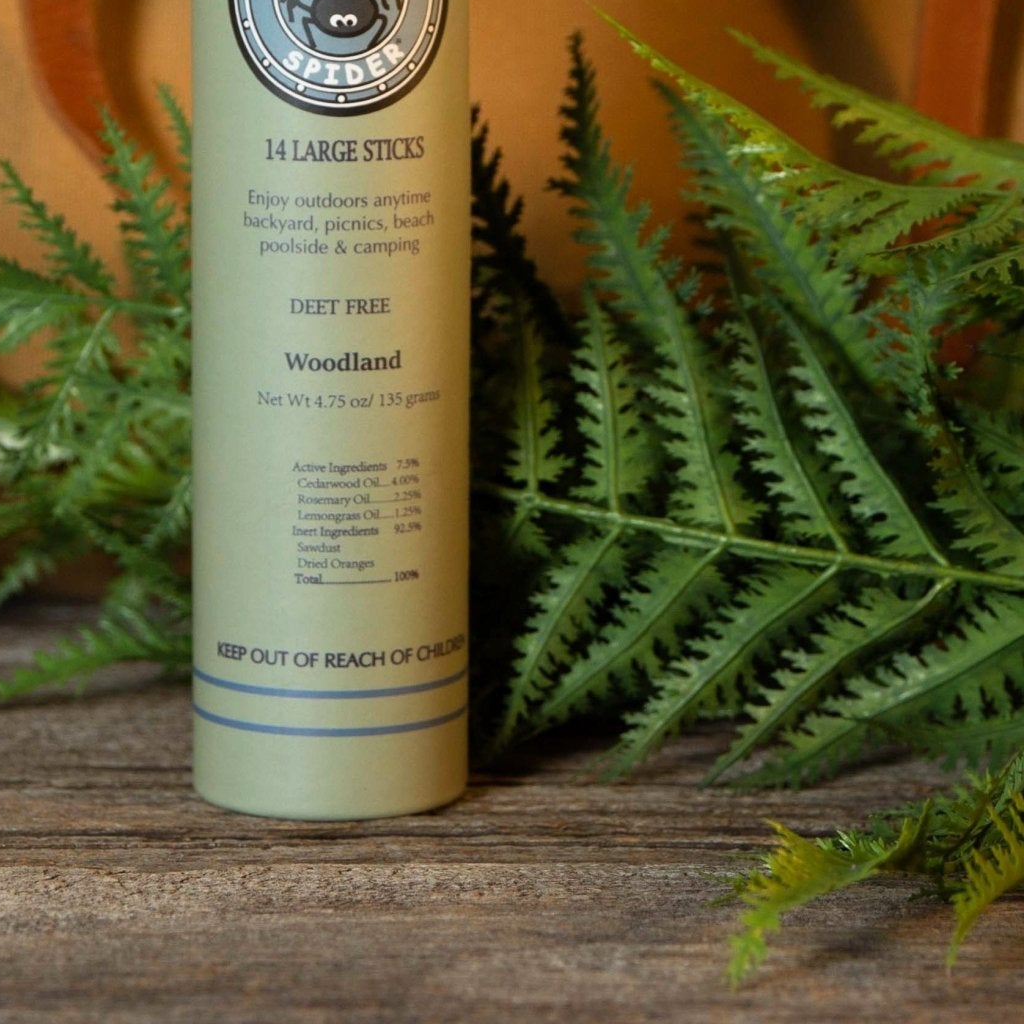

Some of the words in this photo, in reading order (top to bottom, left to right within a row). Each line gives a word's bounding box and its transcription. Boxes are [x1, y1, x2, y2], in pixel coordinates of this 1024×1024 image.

[282, 43, 406, 85] SPIDER
[265, 138, 287, 162] 14
[292, 140, 358, 162] LARGE
[363, 136, 425, 162] STICKS
[248, 190, 289, 210] Enjoy
[294, 193, 368, 209] outdoors
[373, 191, 431, 210] anytime
[243, 211, 318, 232] backyard,
[325, 217, 388, 235] picnics,
[393, 211, 434, 229] beach
[259, 238, 328, 256] poolside
[334, 240, 347, 255] &
[353, 238, 420, 257] camping
[290, 299, 340, 315] DEET
[345, 298, 390, 314] FREE
[285, 350, 402, 372] Woodland
[257, 391, 282, 407] Net
[287, 393, 310, 407] Wt
[314, 395, 345, 408] 4.75
[379, 392, 402, 407] 135
[405, 389, 440, 409] grams
[292, 462, 325, 473] Active
[328, 461, 387, 476] Ingredients
[297, 478, 360, 489] Cedarwood
[363, 478, 379, 488] Oil
[297, 494, 351, 507] Rosemary
[353, 494, 370, 504] Oil
[298, 510, 360, 524] Lemongrass
[363, 510, 380, 520] Oil
[292, 526, 317, 536] Inert
[320, 526, 379, 539] Ingredients
[297, 542, 341, 553] Sawdust
[297, 558, 327, 569] Dried
[331, 558, 375, 571] Oranges
[294, 573, 323, 585] Total
[395, 569, 419, 582] 100%
[217, 642, 247, 660] KEEP
[250, 648, 288, 666] OUT
[293, 652, 319, 668] OF
[325, 651, 386, 668] REACH
[391, 648, 413, 665] OF
